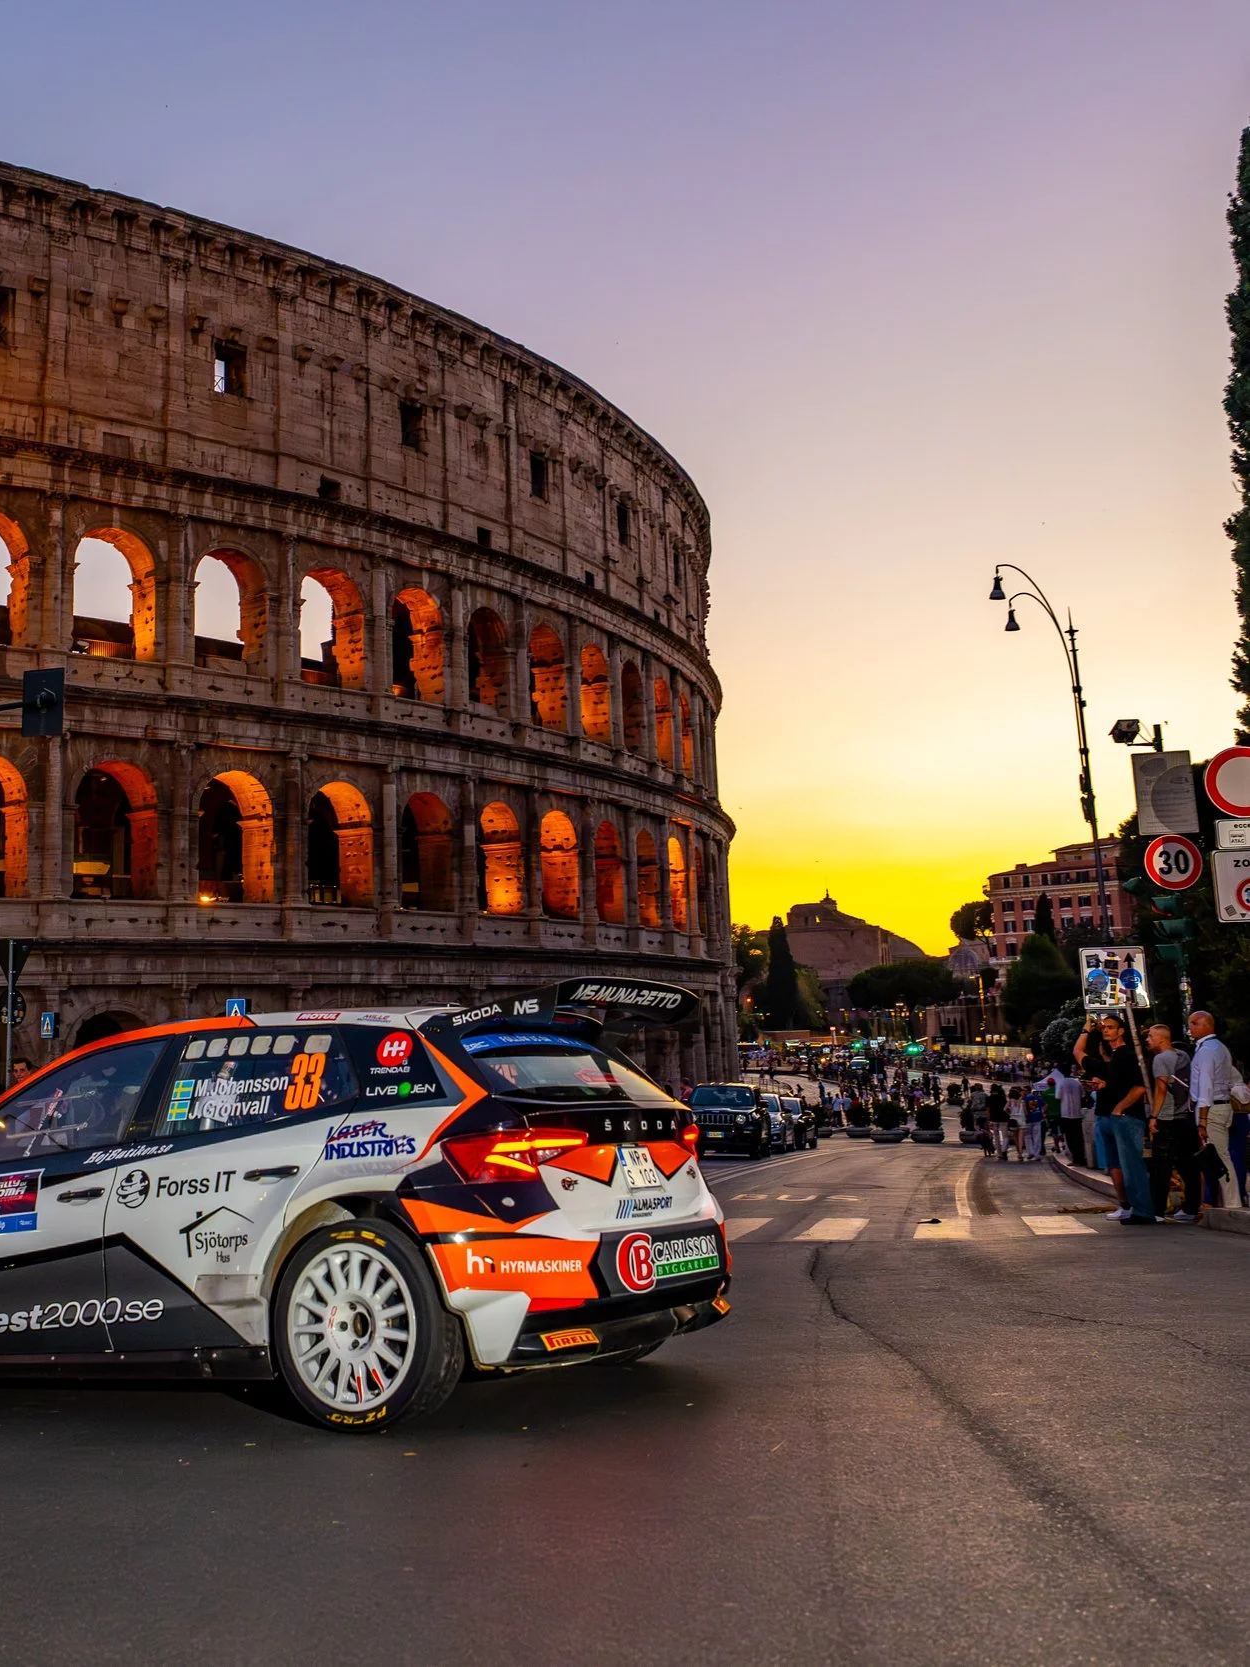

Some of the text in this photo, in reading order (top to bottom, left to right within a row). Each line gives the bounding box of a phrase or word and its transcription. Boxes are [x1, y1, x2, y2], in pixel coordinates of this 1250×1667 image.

[1158, 849, 1190, 875] 30
[298, 1012, 339, 1020] MOTUL
[452, 1003, 502, 1026] SKODA
[283, 1052, 327, 1110] 33
[324, 1136, 416, 1160] INDUSTRIES
[156, 1170, 237, 1198] Forss IT
[194, 1231, 249, 1254] Sjötorps
[652, 1235, 718, 1263] CARLSSON
[216, 1251, 231, 1263] Hus
[500, 1259, 583, 1274] HYRMASKINER
[657, 1259, 704, 1276] BYGGARE
